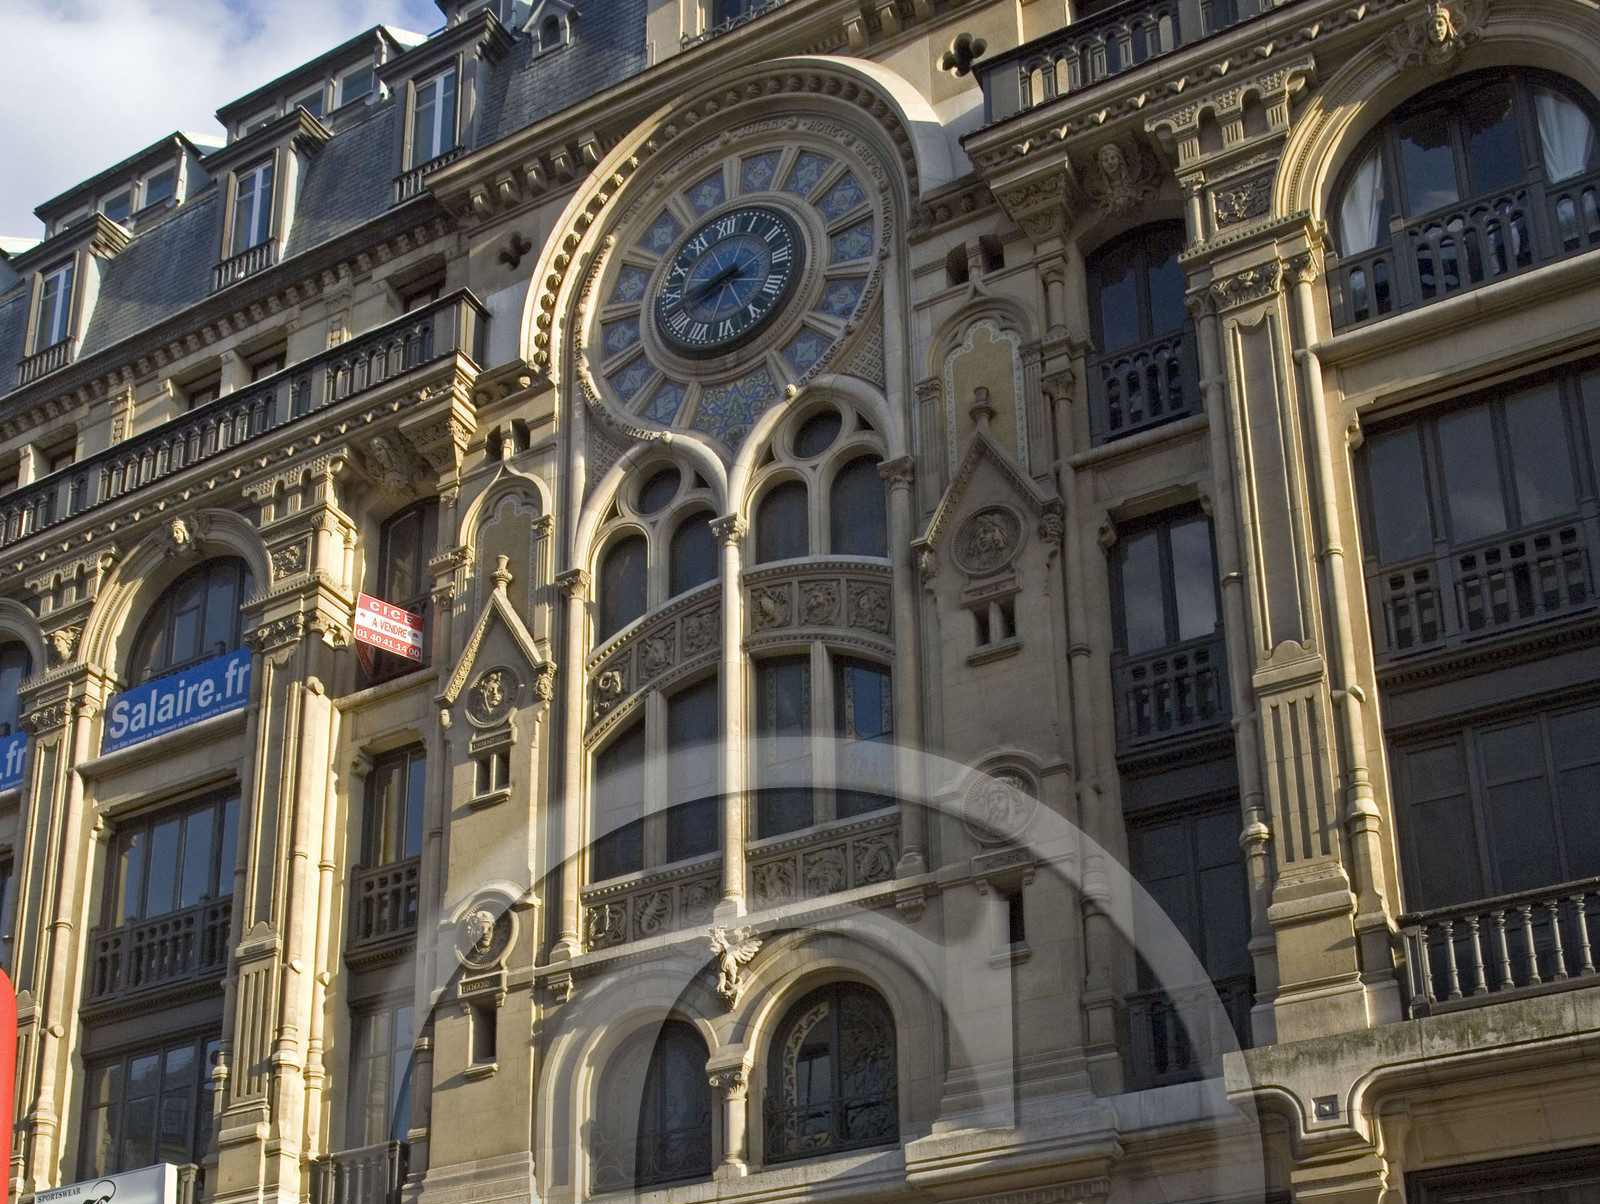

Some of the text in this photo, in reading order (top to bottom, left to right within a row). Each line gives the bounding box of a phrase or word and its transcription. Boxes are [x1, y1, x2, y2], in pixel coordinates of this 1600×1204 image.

[715, 218, 737, 240] XII
[763, 225, 781, 243] II
[690, 236, 709, 256] XI
[771, 246, 789, 264] III
[671, 264, 688, 277] X
[762, 274, 783, 295] IIII
[747, 303, 761, 319] V
[688, 321, 709, 341] VII
[718, 318, 735, 338] VI
[380, 620, 408, 639] VENDRE
[109, 658, 251, 739] Salaire.fr
[37, 1186, 81, 1203] SPORTSWEAR
